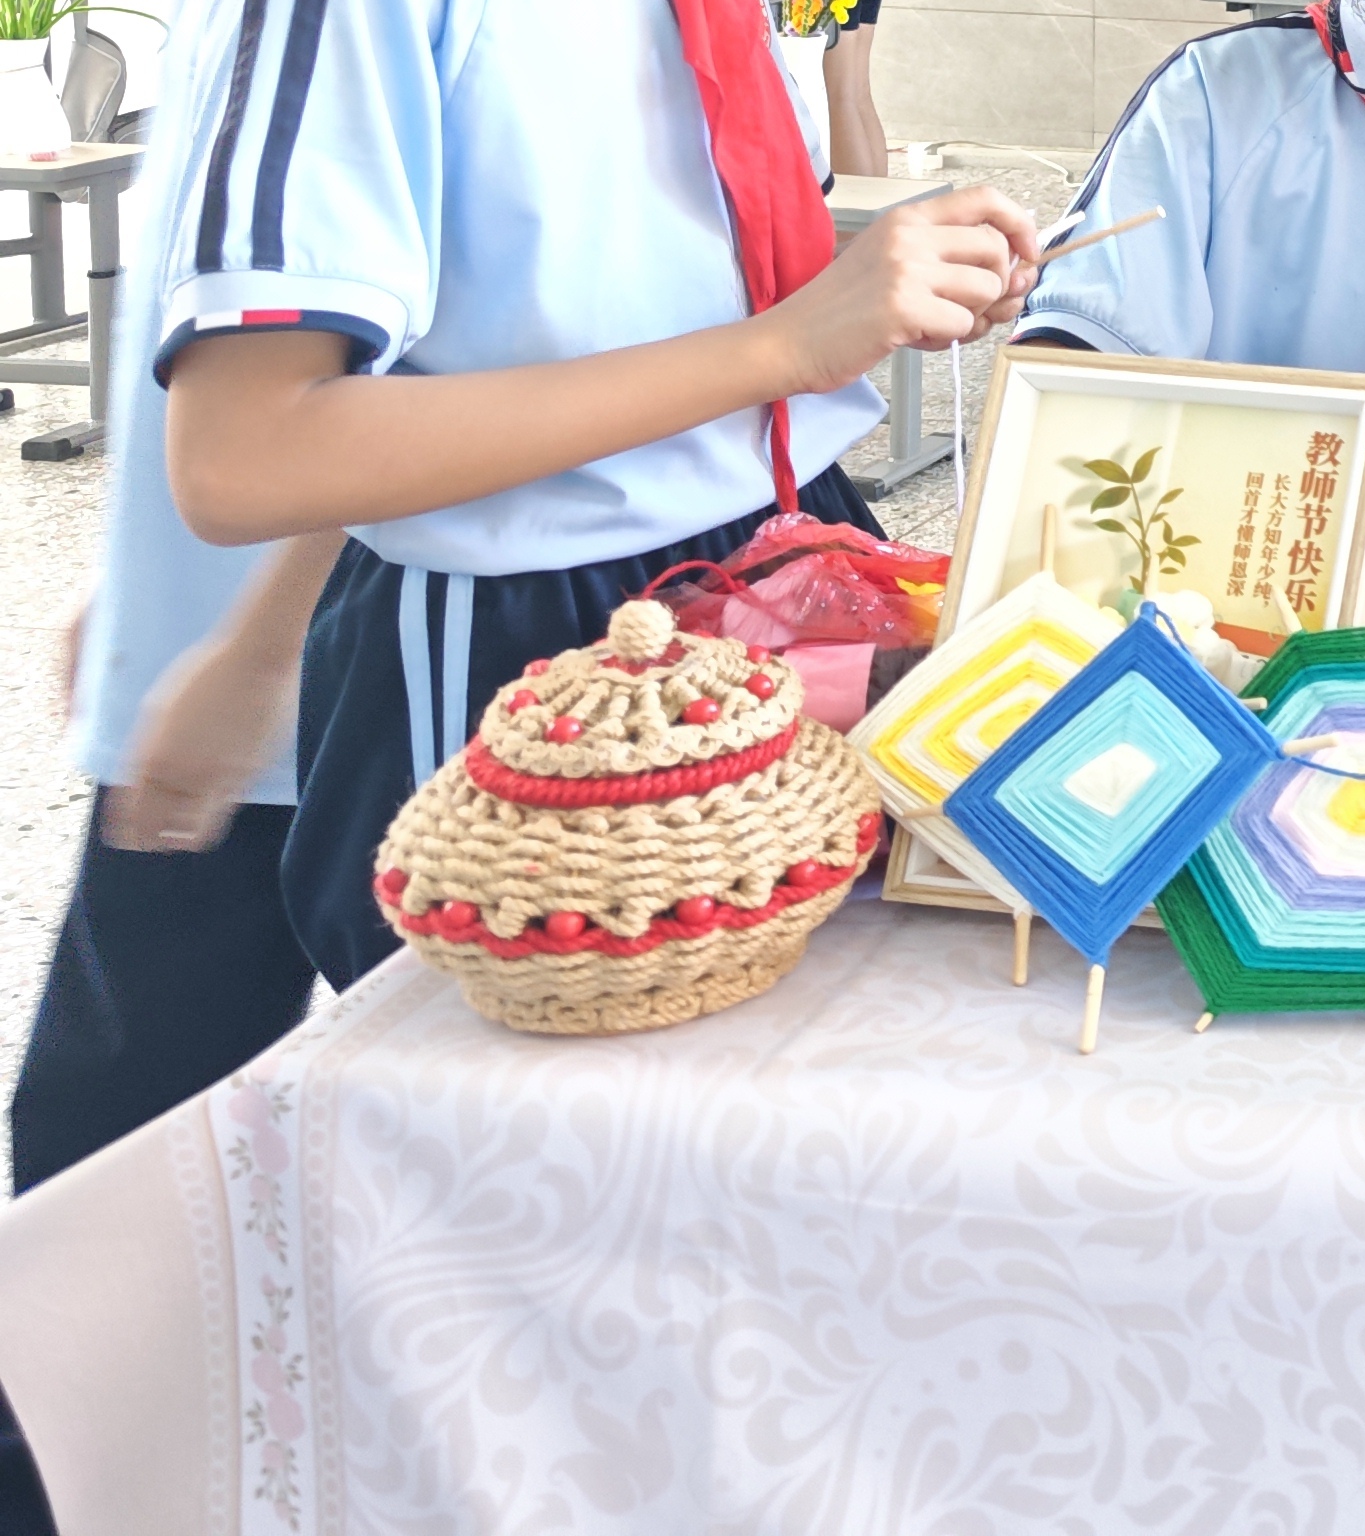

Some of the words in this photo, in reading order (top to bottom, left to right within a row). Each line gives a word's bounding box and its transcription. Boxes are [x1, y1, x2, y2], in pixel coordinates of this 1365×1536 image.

[1226, 471, 1265, 598] 回首才懂师恩深
[1285, 431, 1346, 613] 教师节快乐
